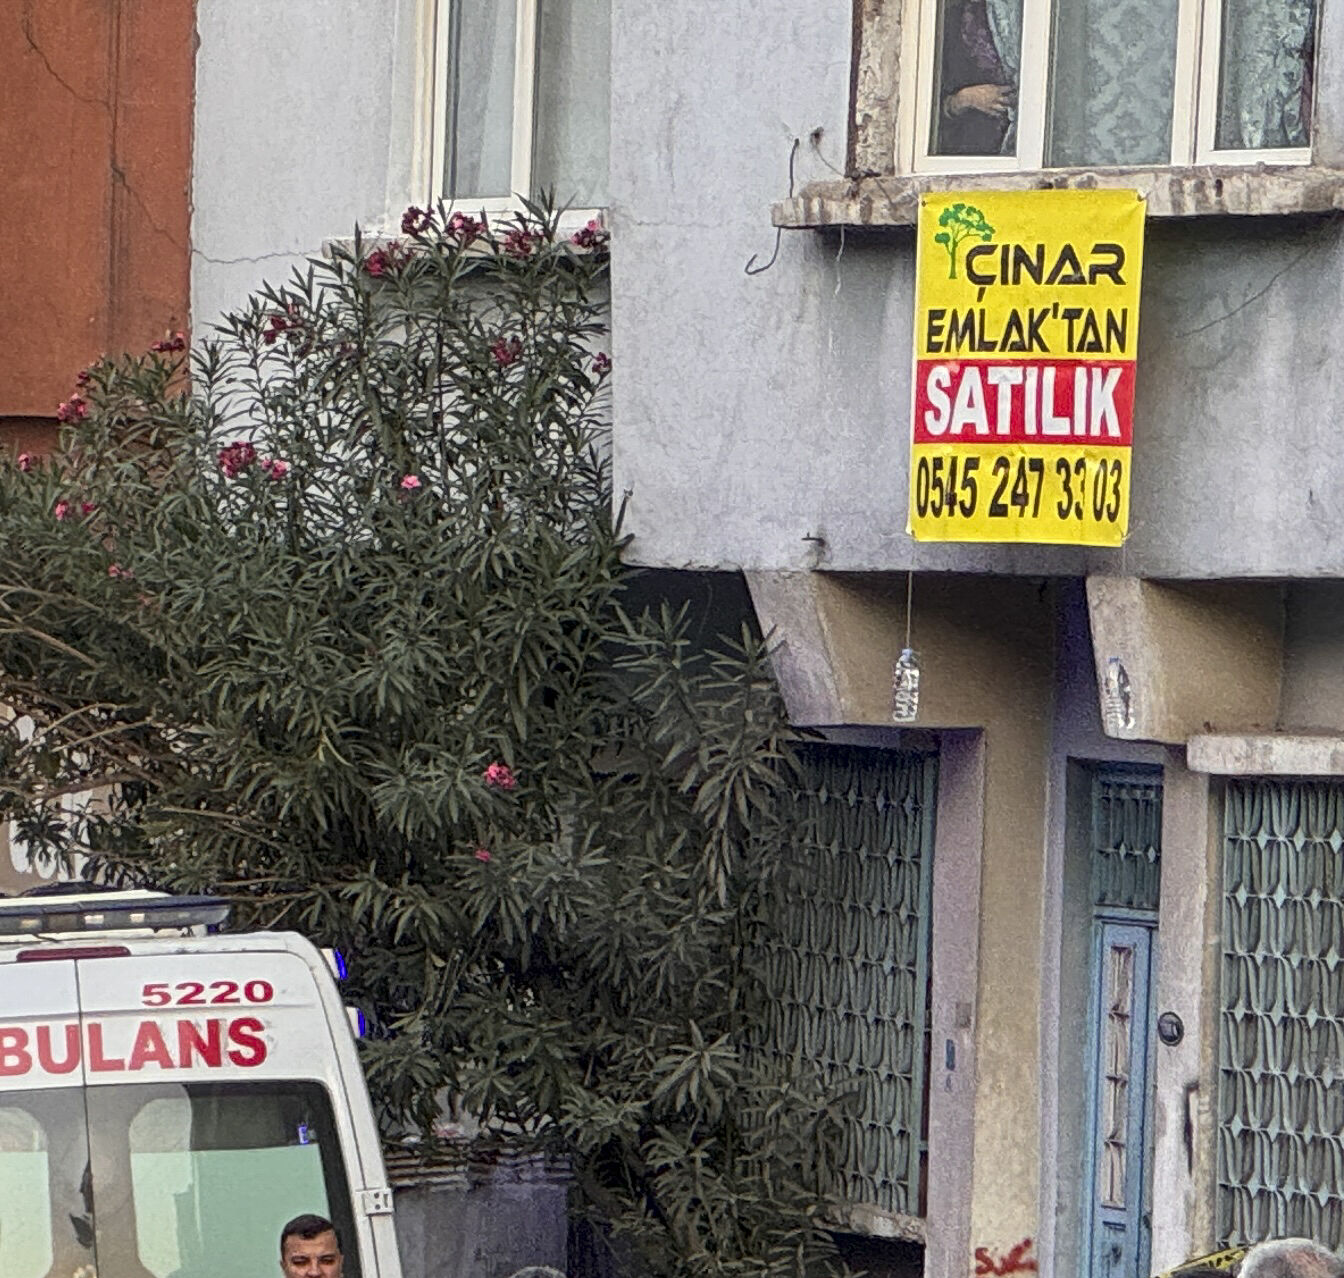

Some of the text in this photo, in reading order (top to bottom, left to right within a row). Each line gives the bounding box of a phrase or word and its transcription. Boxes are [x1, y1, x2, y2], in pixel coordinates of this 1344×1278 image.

[966, 243, 1126, 302] ÇINAR
[926, 302, 1128, 353] EMLAK'TAN
[924, 366, 1123, 436] SATILIK
[917, 456, 980, 518] 0545
[988, 456, 1045, 518] 247
[1092, 459, 1123, 523] 03
[142, 980, 275, 1006] 5220
